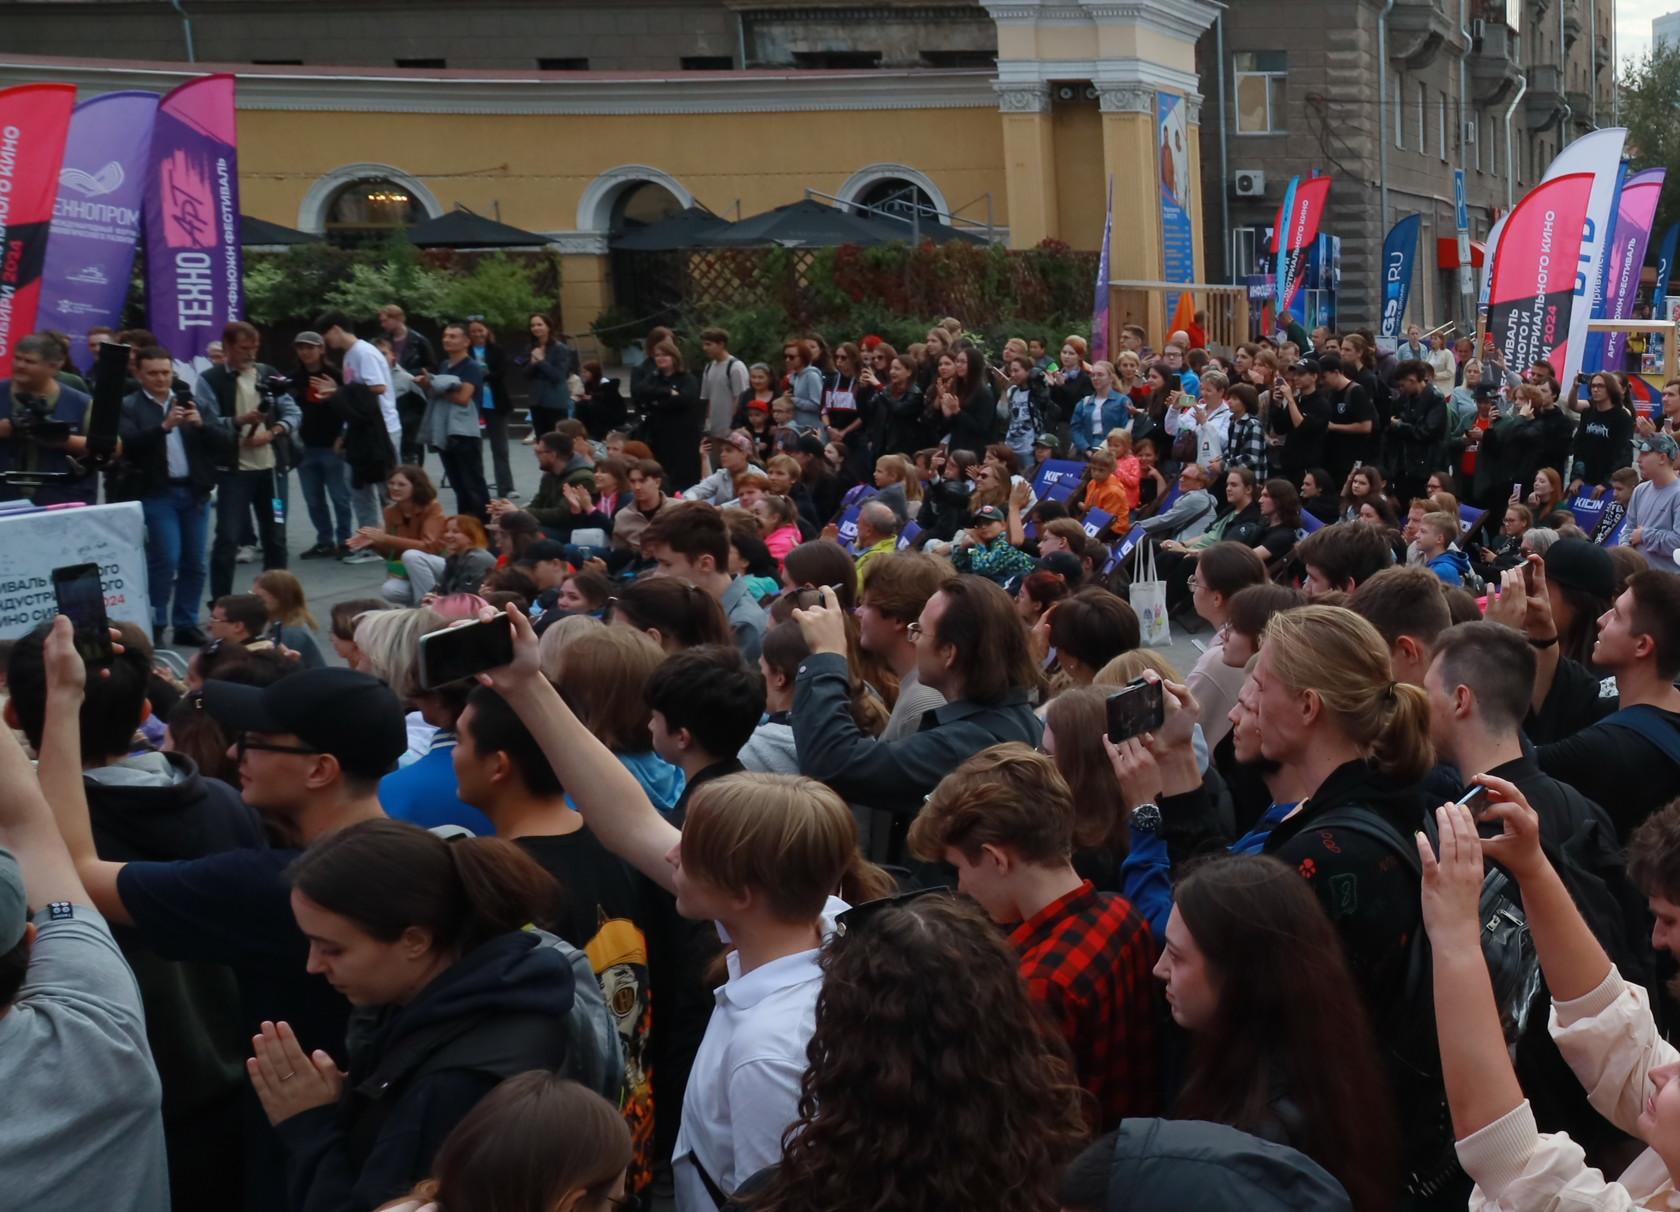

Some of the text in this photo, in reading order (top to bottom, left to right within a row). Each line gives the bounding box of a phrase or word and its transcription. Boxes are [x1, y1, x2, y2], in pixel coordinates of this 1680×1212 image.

[216, 157, 236, 244] ФЕСТИВАЛЬ
[1541, 209, 1556, 253] КИНО
[175, 252, 213, 331] ТЕХНО
[1388, 251, 1404, 281] RU
[1619, 237, 1637, 297] ФЕСТИВАЛЬ
[1543, 305, 1559, 343] 2024
